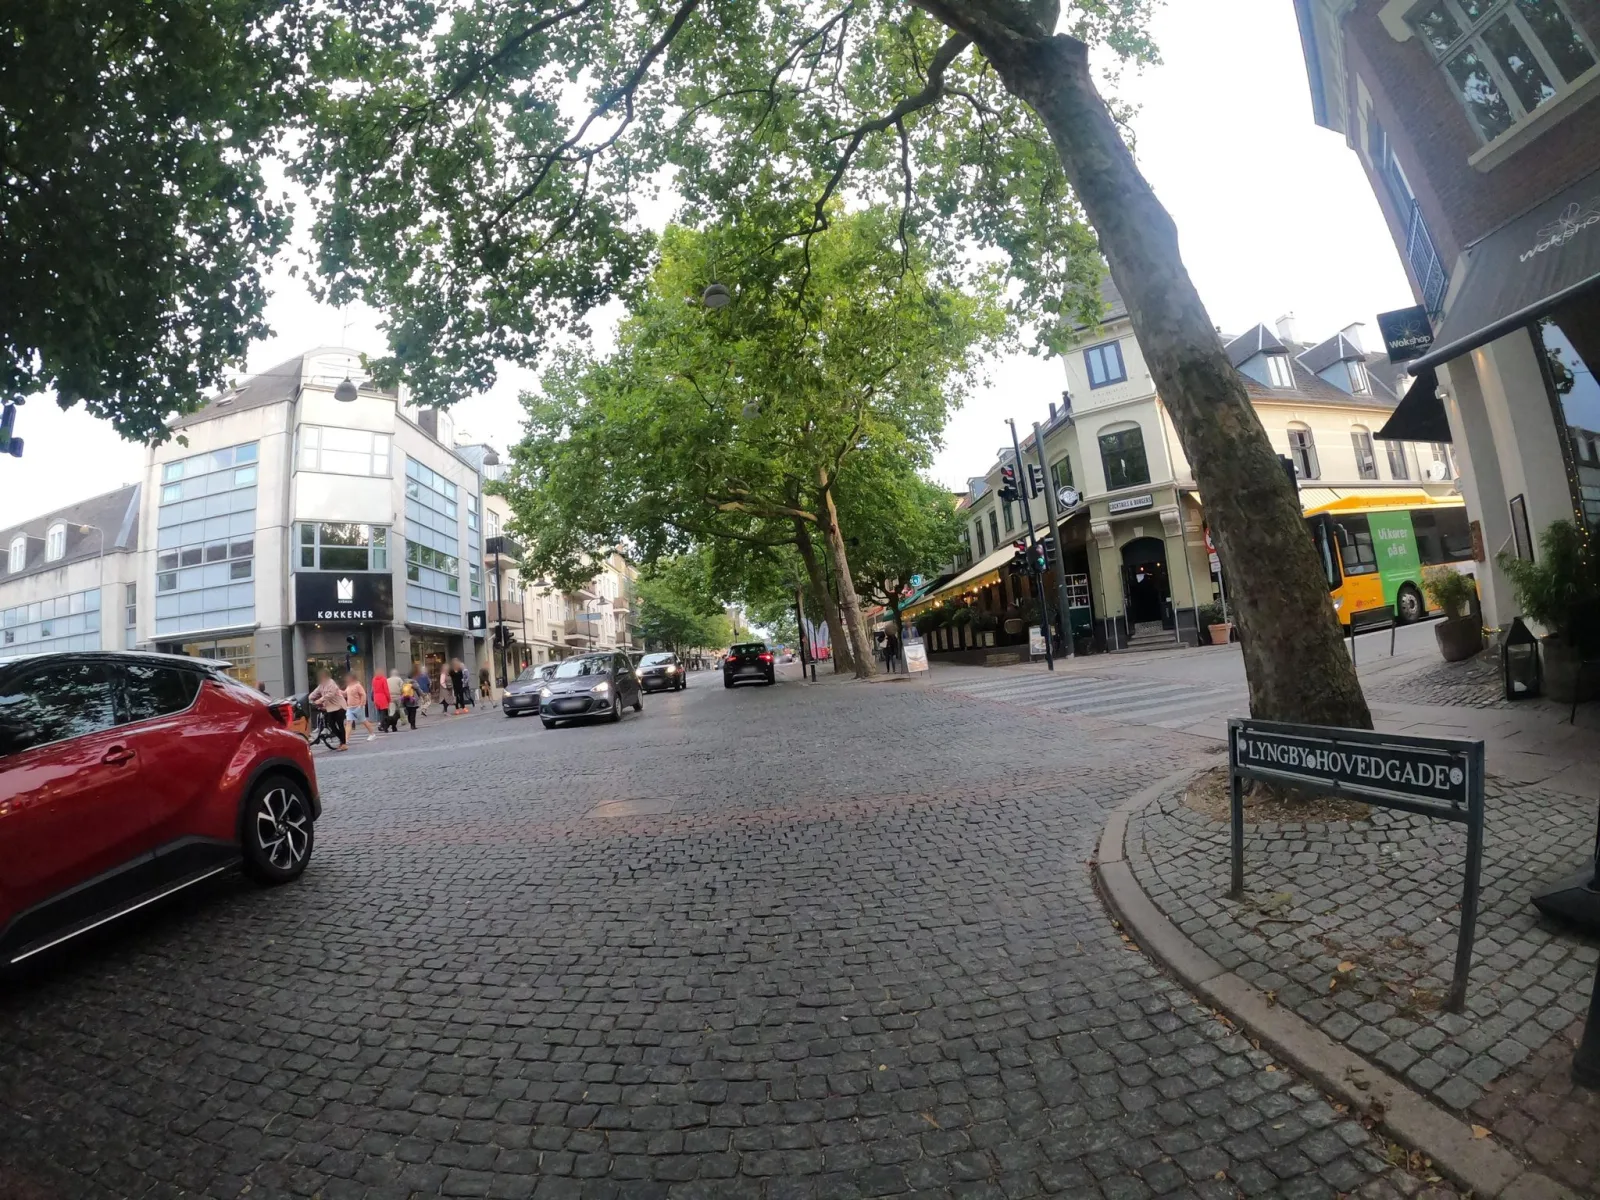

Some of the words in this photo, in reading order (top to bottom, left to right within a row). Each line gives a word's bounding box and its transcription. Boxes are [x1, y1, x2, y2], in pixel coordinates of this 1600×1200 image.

[1519, 215, 1600, 262] Woksho
[1389, 335, 1431, 349] Wokshop
[1378, 528, 1387, 539] Vi
[1388, 543, 1398, 558] på
[317, 610, 374, 619] KØKKENER
[1248, 740, 1310, 768] LYNGBY
[1316, 749, 1451, 790] HOVEDGADE
